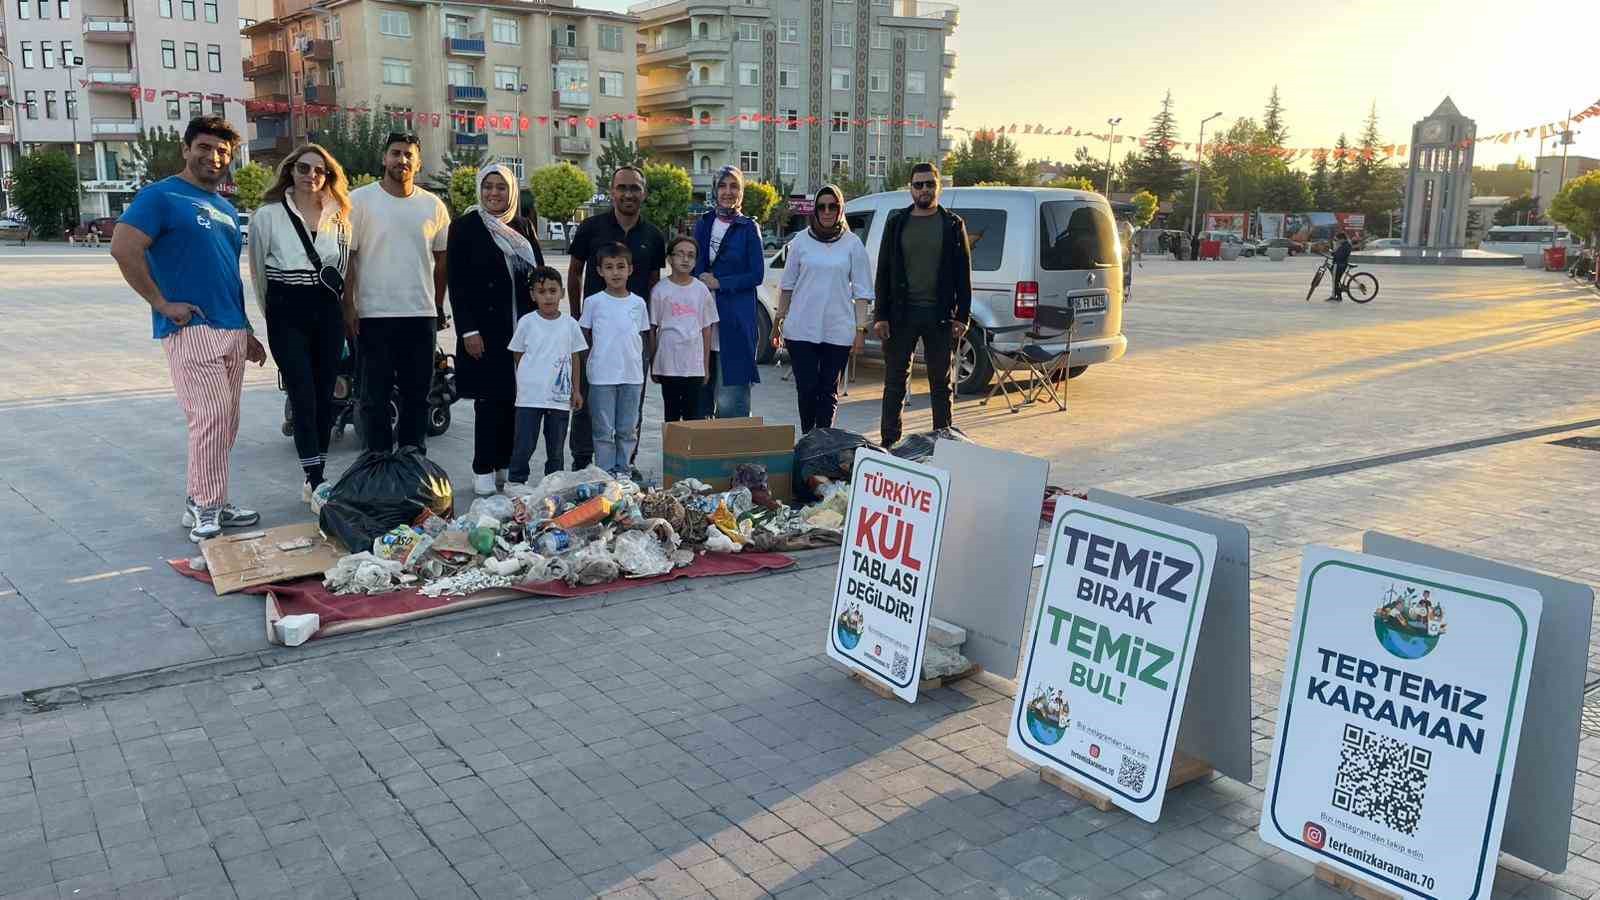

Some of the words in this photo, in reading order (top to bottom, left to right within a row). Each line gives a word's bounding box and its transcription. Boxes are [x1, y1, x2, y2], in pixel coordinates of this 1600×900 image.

[864, 472, 932, 512] TÜRKİYE
[855, 505, 921, 571] KÜL
[852, 550, 918, 597] TABLASI
[1076, 576, 1156, 624] BIRAK
[1069, 662, 1126, 705] BUL!
[1306, 676, 1485, 755] KARAMAN
[1334, 817, 1385, 844] instagramdan
[1328, 836, 1435, 891] tertemizkaraman.70
